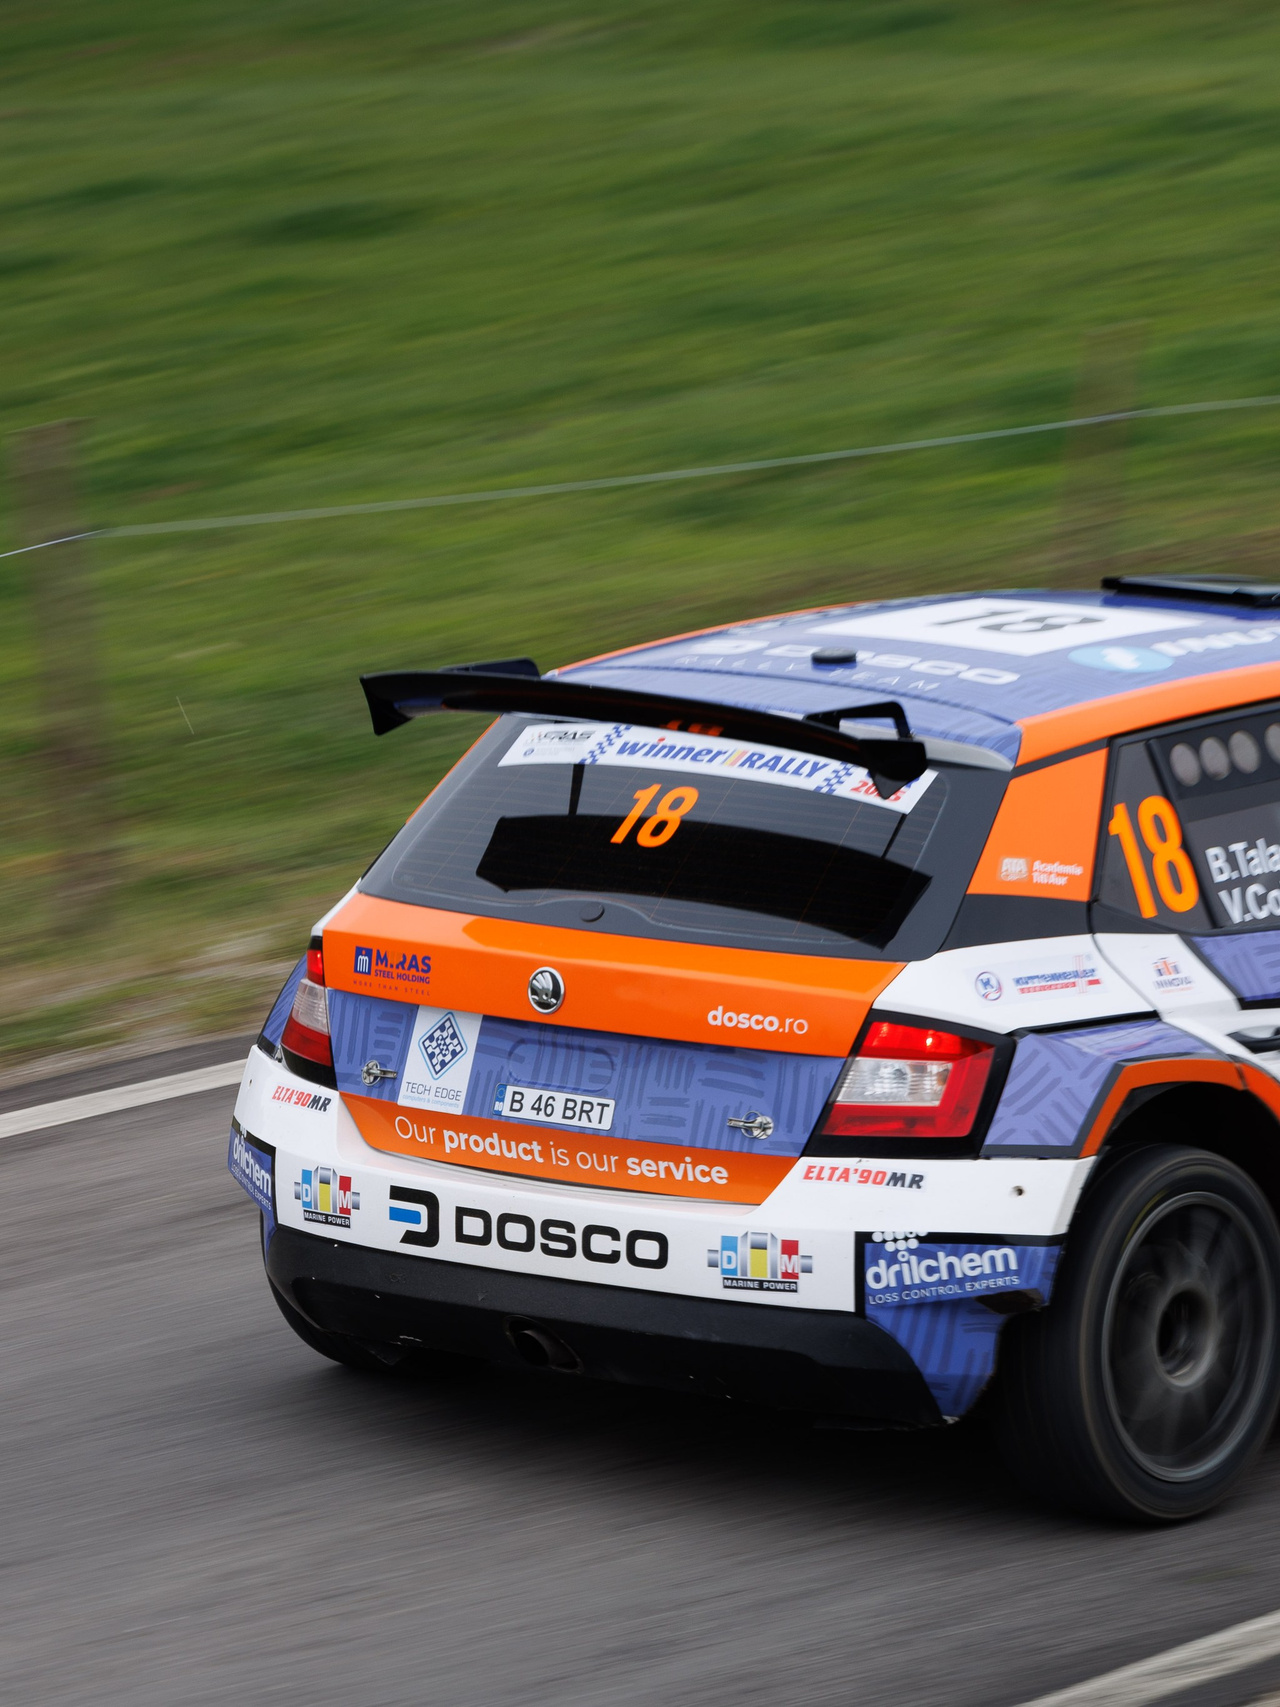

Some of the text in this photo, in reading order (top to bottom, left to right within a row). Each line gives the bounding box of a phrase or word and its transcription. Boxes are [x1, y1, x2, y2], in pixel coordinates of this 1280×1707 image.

[616, 737, 728, 764] winner
[740, 752, 832, 778] RALLY
[610, 784, 699, 848] 18
[1108, 795, 1200, 919] 18
[374, 969, 430, 984] STEEL HOLDING
[707, 1006, 808, 1035] dosco.ro
[405, 1081, 462, 1102] TECH EDGE
[509, 1091, 610, 1125] B 46 BRT
[233, 1133, 271, 1197] drilchem
[394, 1116, 729, 1185] Our product is our service
[304, 1212, 350, 1226] MARINE POWER
[455, 1205, 669, 1270] DOSCO
[723, 1279, 797, 1290] MARINE POWER
[865, 1247, 1018, 1290] drilchem
[869, 1275, 1020, 1305] LOSS CONTROL EXPERTS
